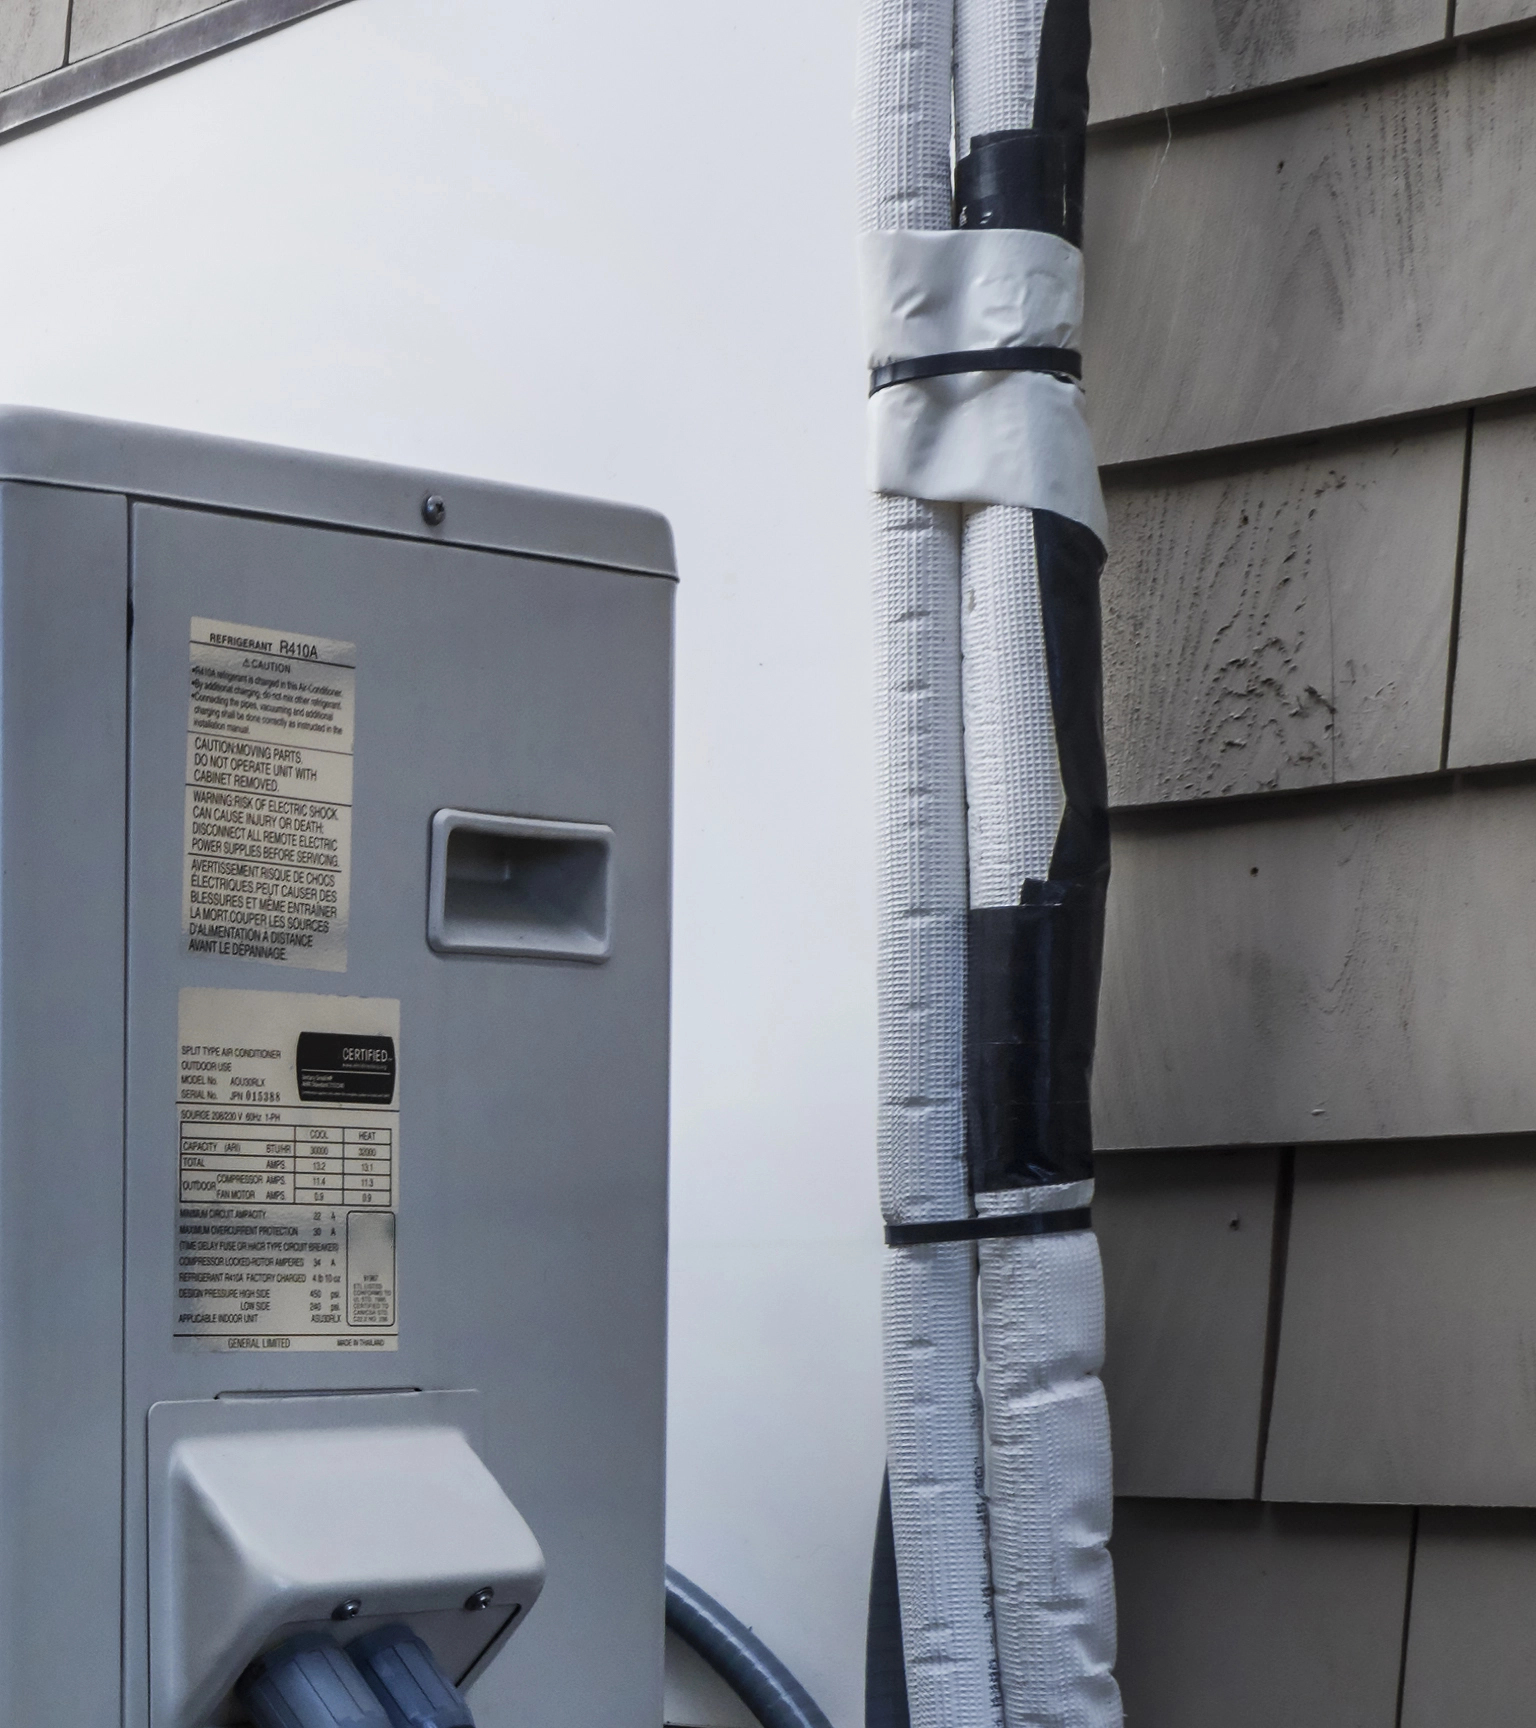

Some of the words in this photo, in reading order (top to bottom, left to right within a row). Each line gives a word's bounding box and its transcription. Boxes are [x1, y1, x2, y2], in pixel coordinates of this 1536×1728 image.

[209, 632, 272, 651] REFRIGERANT
[279, 639, 318, 659] R410A
[251, 658, 290, 673] CAUTION
[194, 752, 207, 766] DO
[210, 754, 228, 769] NOT
[230, 757, 270, 775] OPERATE
[273, 763, 292, 778] UNIT
[294, 766, 317, 781] WITH
[193, 768, 231, 786] CABINET
[255, 797, 266, 811] OF
[268, 799, 307, 816] ELECTRIC
[192, 805, 211, 820] CAN
[213, 807, 243, 824] CAUSE
[246, 812, 276, 828] INJURY
[278, 816, 292, 830] OR
[192, 821, 245, 840] DISCONNECT
[247, 828, 261, 842] ALL
[263, 830, 297, 846] REMOTE
[298, 834, 337, 851] ELECTRIC
[191, 837, 221, 853] POWER
[223, 841, 261, 858] SUPPLIES
[262, 846, 294, 862] BEFORE
[293, 870, 304, 883] DE
[305, 871, 335, 887] CHOCS
[190, 890, 243, 908] BLESSURES
[245, 896, 257, 909] ET
[281, 884, 317, 900] CAUSER
[319, 888, 337, 903] DES
[189, 906, 200, 919] LA
[269, 914, 285, 928] LES
[287, 916, 330, 933] SOURCES
[188, 938, 216, 953] AVANT
[218, 941, 230, 955] LE
[270, 930, 312, 947] DISTANCE
[342, 1047, 388, 1062] CERTIFIED
[228, 1338, 259, 1348] GENERAL
[262, 1338, 290, 1348] LIMITED
